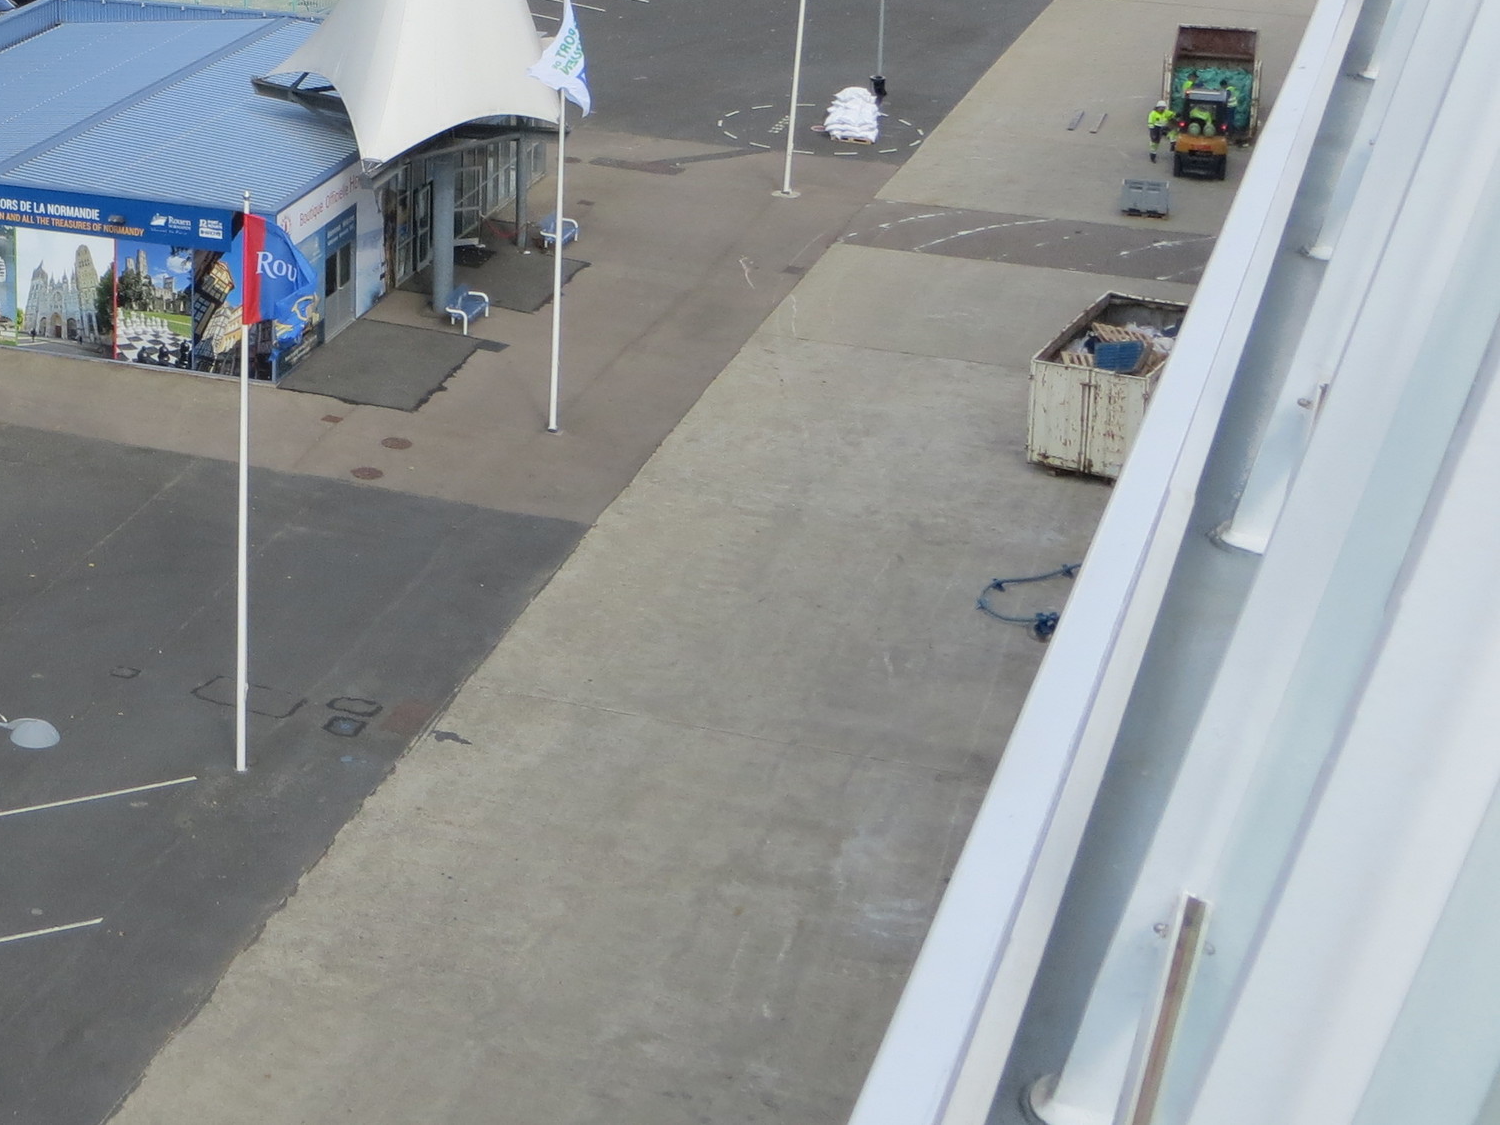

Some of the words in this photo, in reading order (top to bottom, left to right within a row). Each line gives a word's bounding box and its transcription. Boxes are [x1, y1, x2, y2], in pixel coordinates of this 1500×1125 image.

[20, 201, 32, 212] DE
[33, 202, 46, 214] LA
[47, 203, 100, 221] NORMANDIE
[6, 212, 20, 222] AND
[22, 214, 34, 224] ALL
[36, 215, 49, 226] THE
[51, 217, 92, 231] TREASURES
[92, 222, 102, 231] OF
[103, 223, 145, 236] NORMANDY
